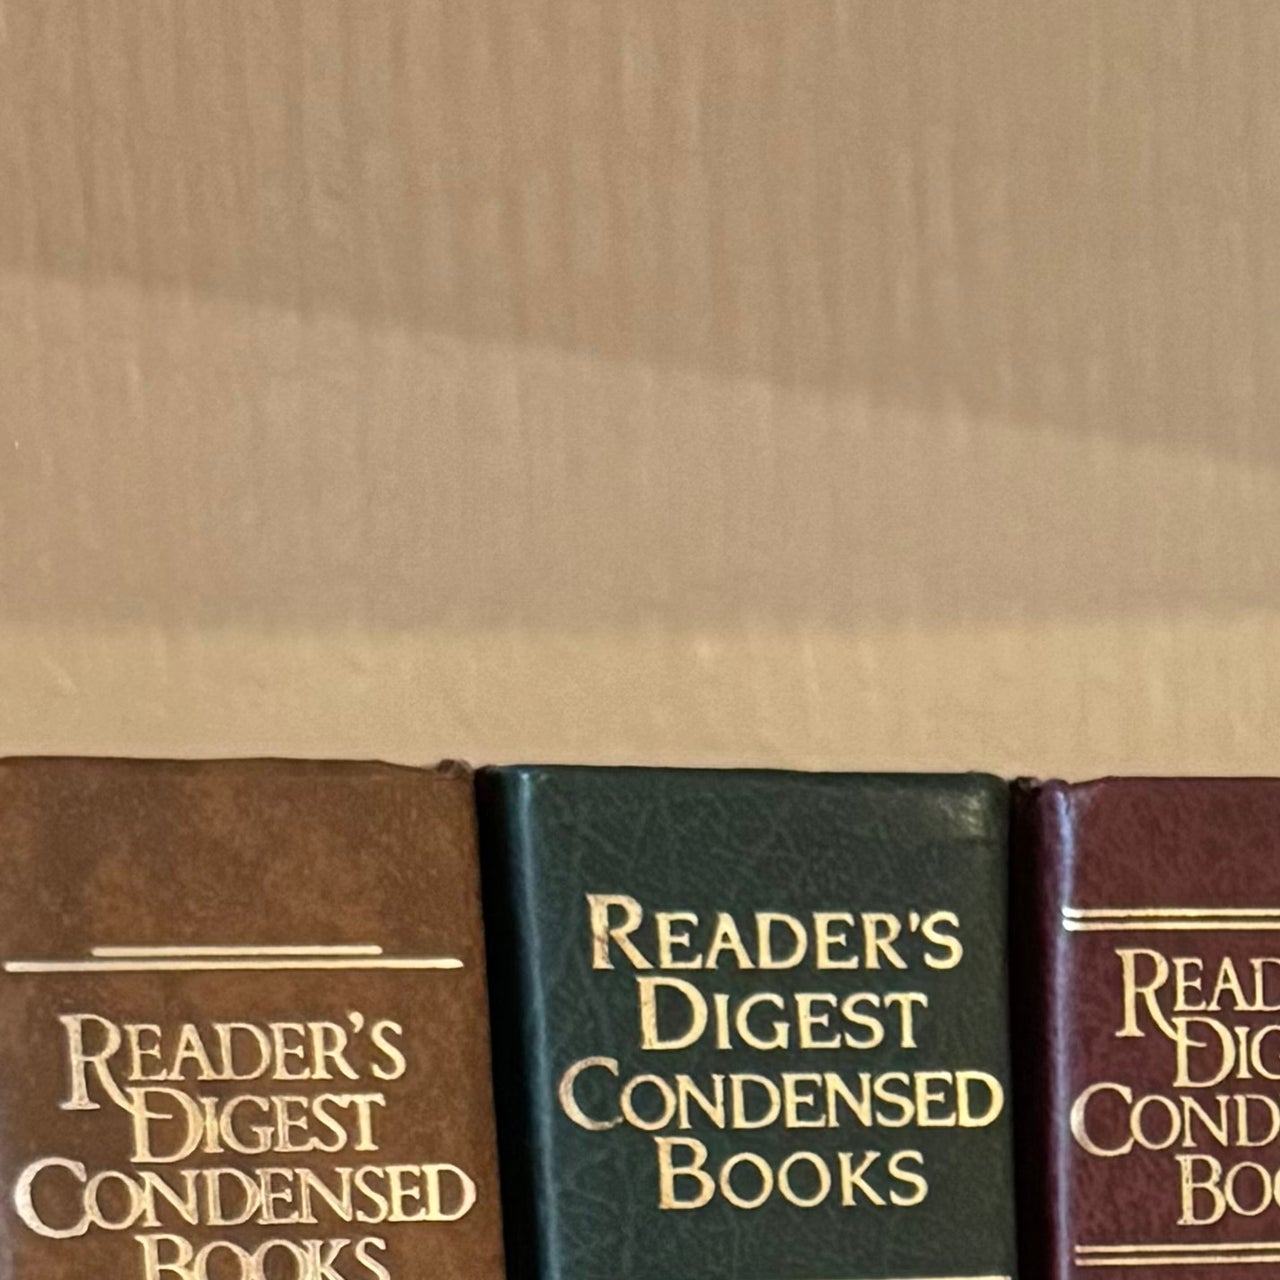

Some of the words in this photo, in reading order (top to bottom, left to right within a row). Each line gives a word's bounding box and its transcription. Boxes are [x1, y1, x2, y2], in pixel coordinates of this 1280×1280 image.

[585, 893, 964, 971] READER'S
[636, 975, 929, 1050] DIGEST
[59, 1010, 407, 1112] READER'S
[558, 1055, 1004, 1130] CONDENSED
[125, 1086, 386, 1163] DIGEST
[13, 1157, 477, 1239] CONDENSED
[653, 1136, 929, 1210] BOOKS
